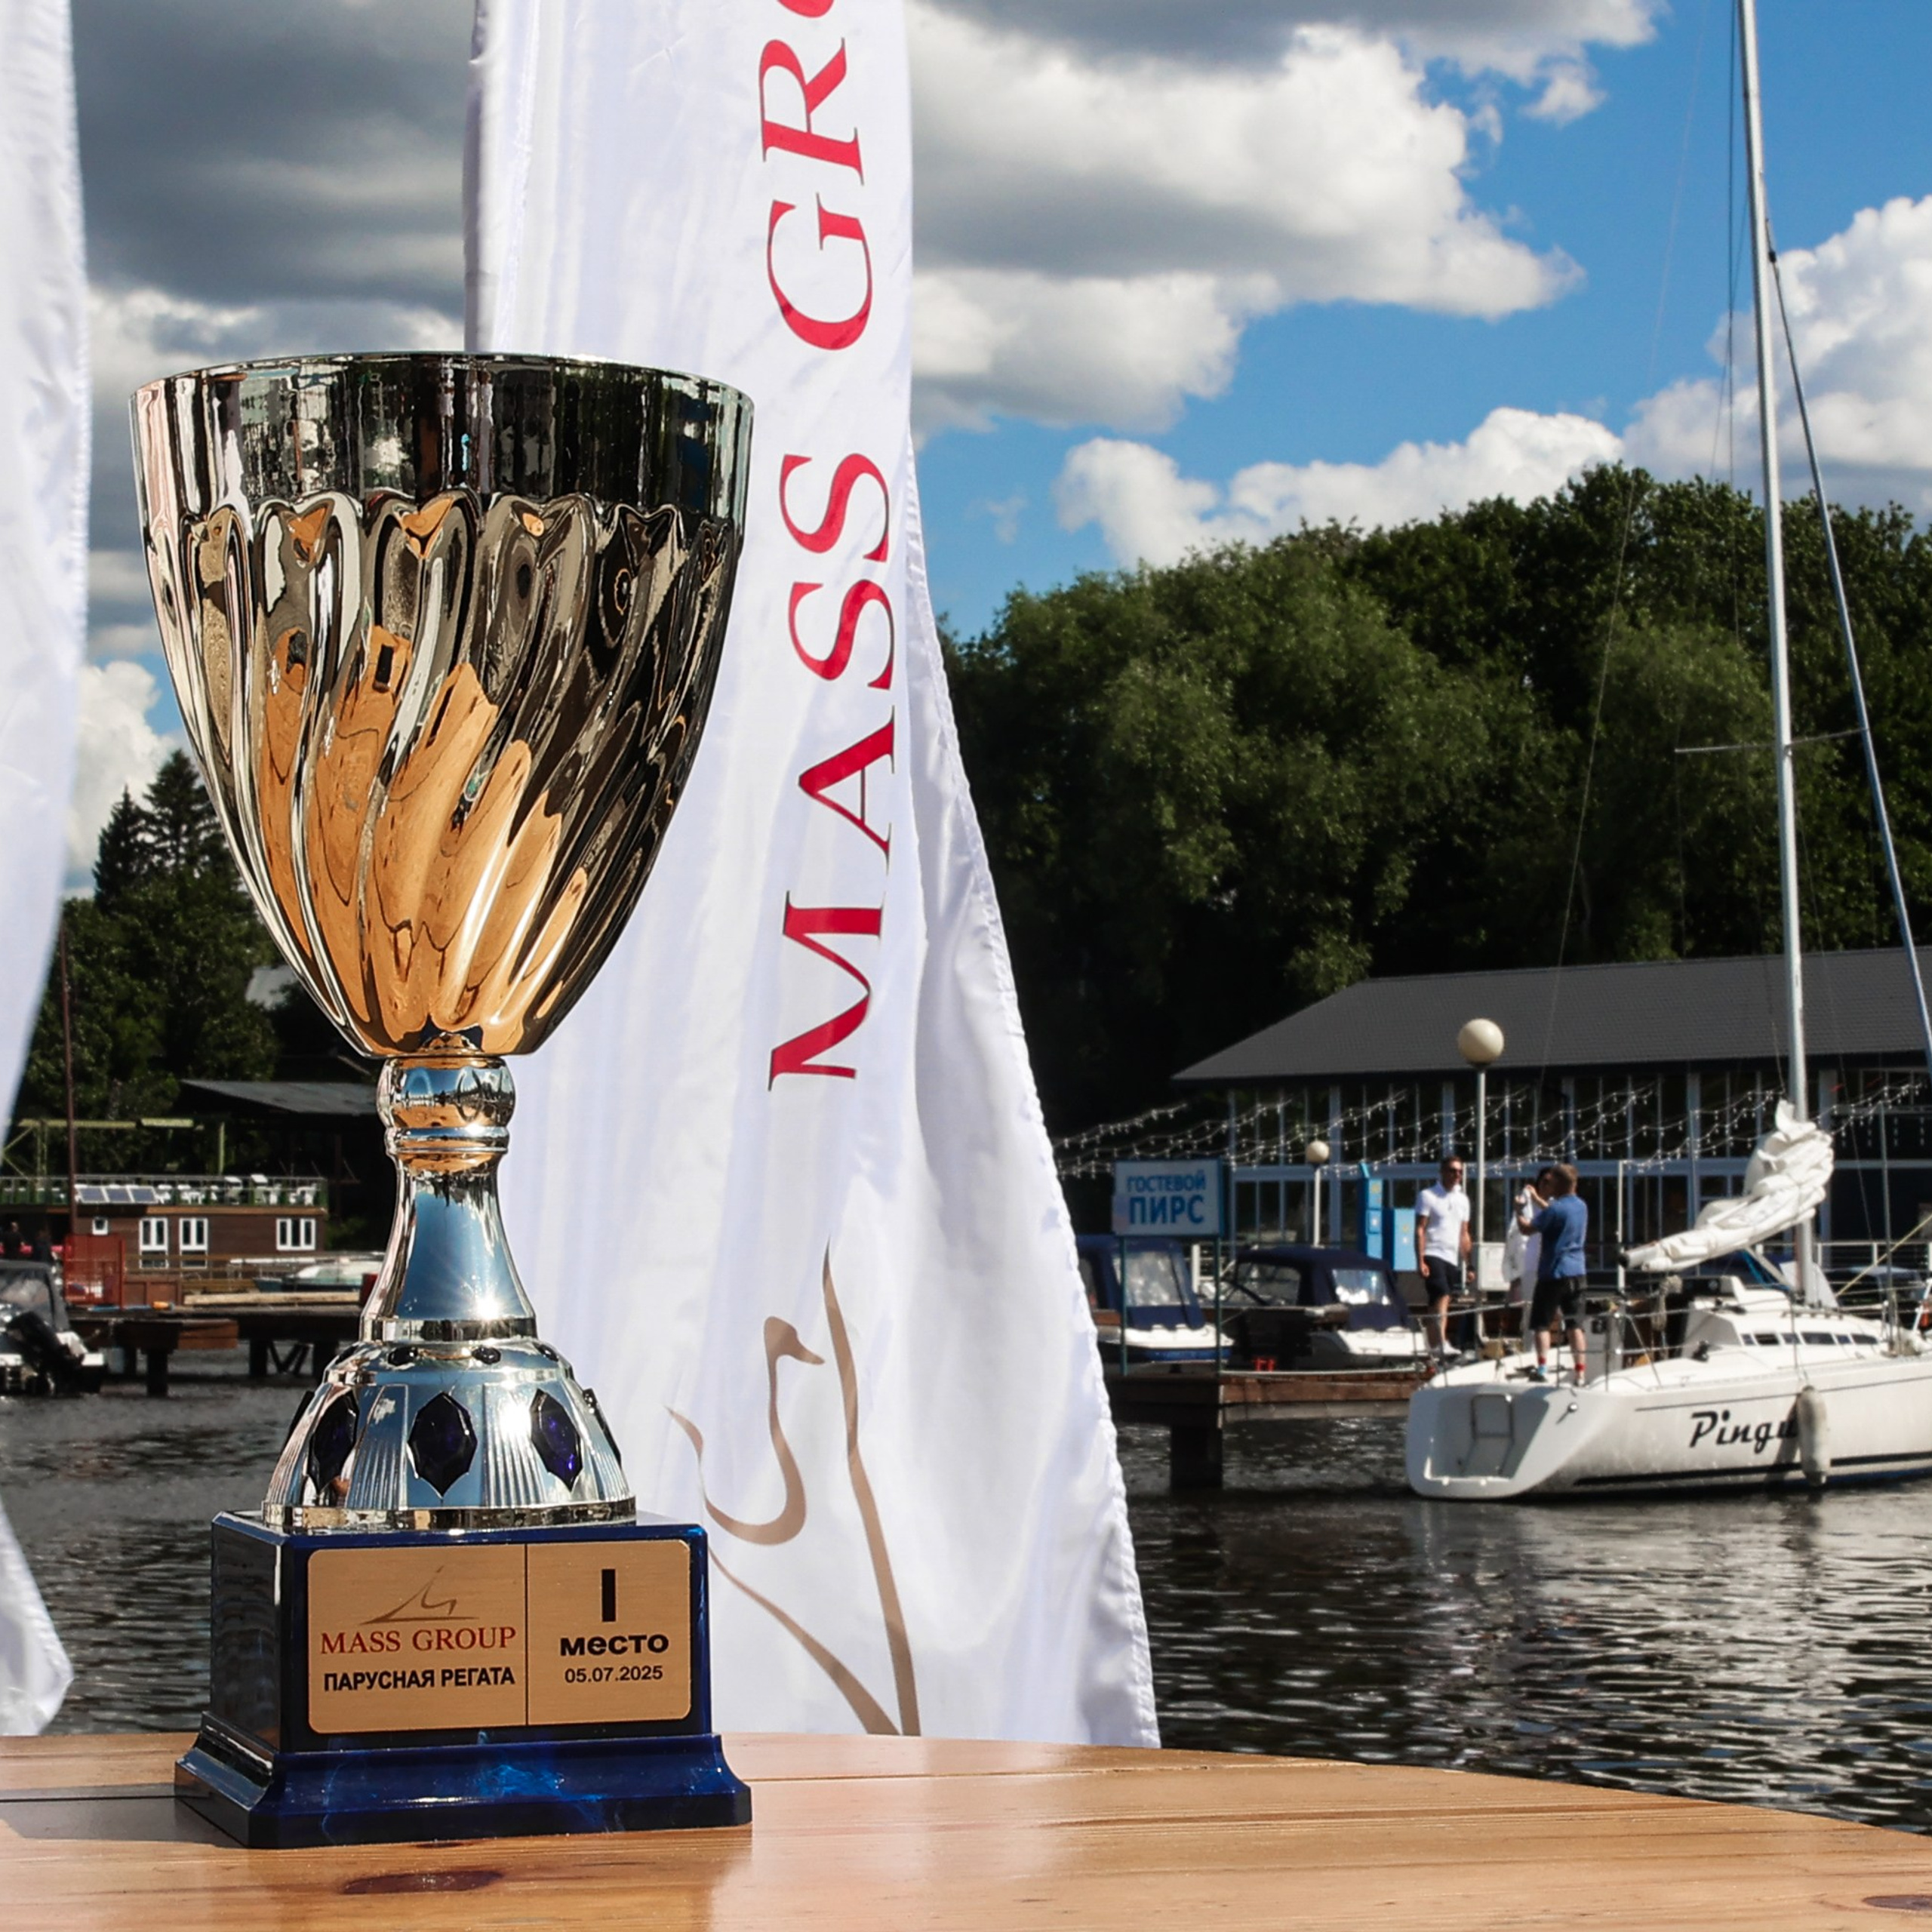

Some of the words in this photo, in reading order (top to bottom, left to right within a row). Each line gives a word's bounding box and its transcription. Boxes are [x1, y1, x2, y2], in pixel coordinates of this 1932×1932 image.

[759, 0, 874, 352] GR
[768, 453, 894, 1091] MASS
[1127, 1170, 1206, 1192] ГОСТЕВОЙ
[1130, 1195, 1204, 1224] ПИРС
[321, 1630, 401, 1655] MASS
[412, 1626, 516, 1651] GROUP
[560, 1633, 669, 1657] место
[324, 1668, 435, 1692] ПАРУСНАЯ
[441, 1666, 515, 1687] РЕГАТА
[565, 1665, 663, 1684] 05.07.2025
